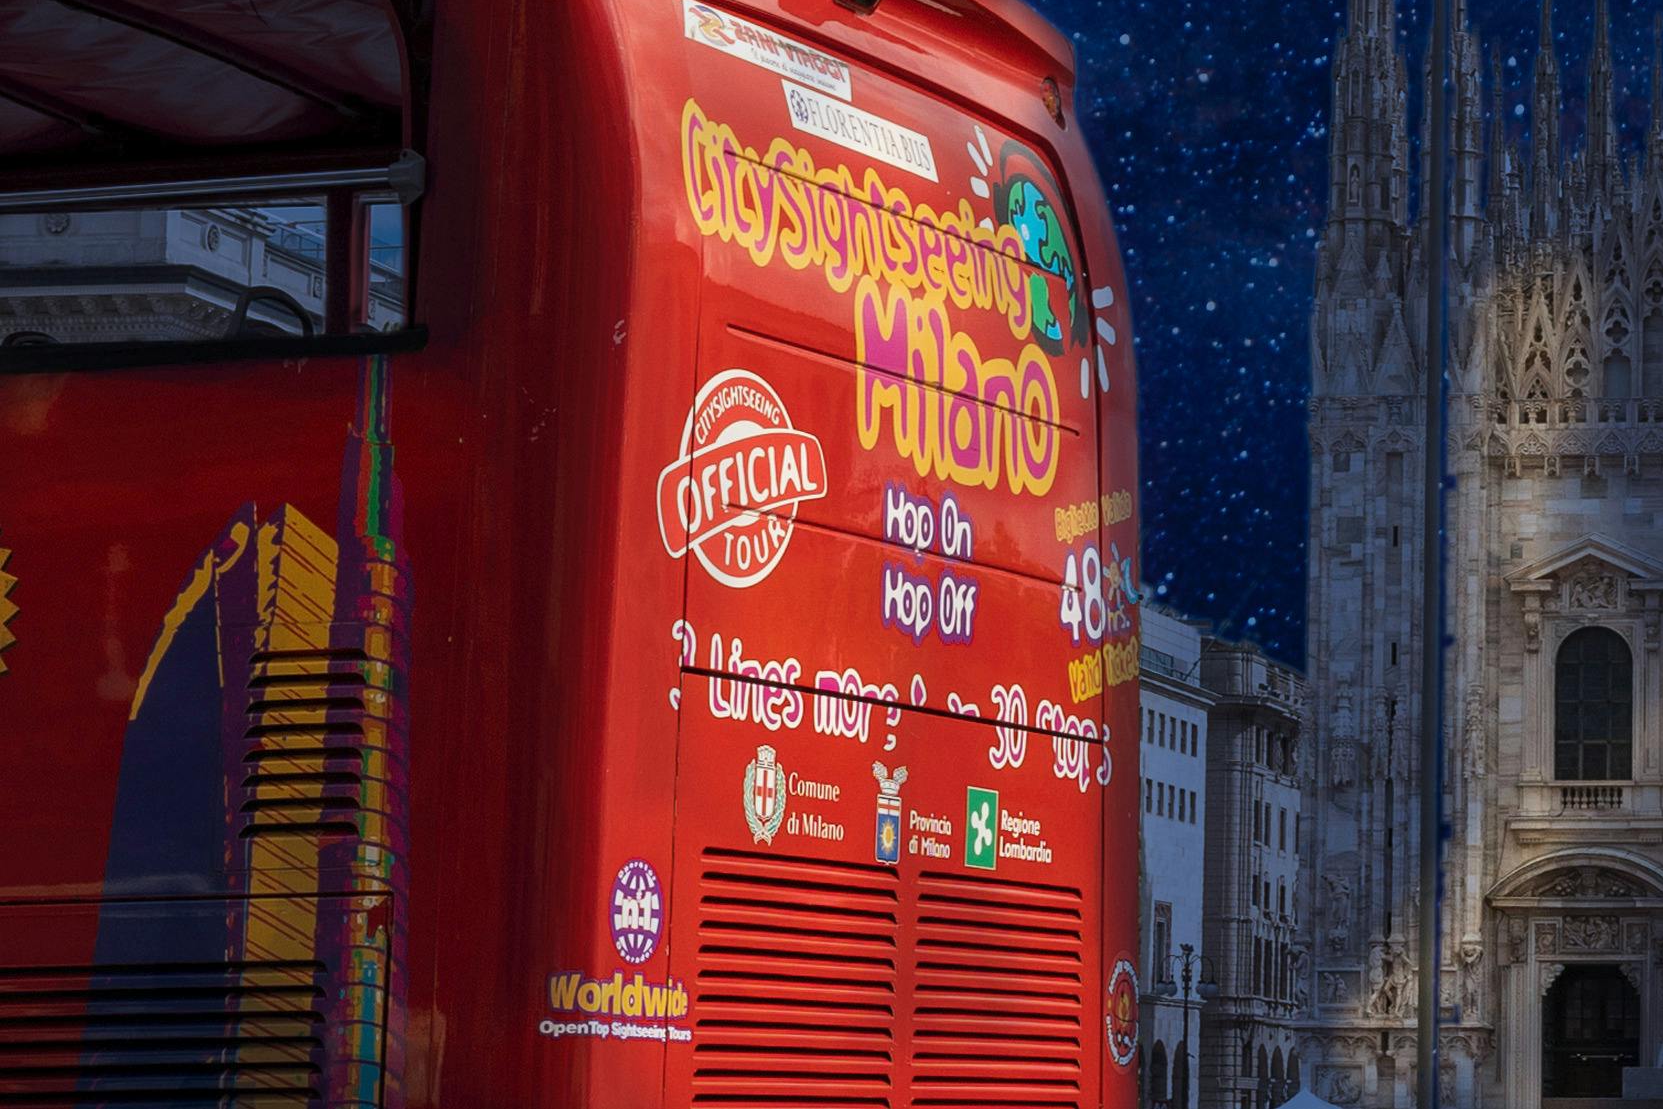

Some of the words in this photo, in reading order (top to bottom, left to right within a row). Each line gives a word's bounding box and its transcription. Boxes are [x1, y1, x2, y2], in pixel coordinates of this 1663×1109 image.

[807, 98, 901, 159] FLORENTIA
[898, 133, 931, 172] BUS
[854, 274, 1060, 497] Milano
[694, 385, 781, 445] CITYSIGHTSEEING
[676, 442, 818, 534] OFFICIAL
[723, 514, 786, 571] TOUR
[886, 488, 934, 556] Hop
[940, 497, 972, 558] On
[884, 568, 933, 637] Hop
[938, 576, 977, 637] Off
[1060, 546, 1106, 641] 48
[708, 632, 804, 732] Lines
[988, 683, 1028, 770] 30
[788, 772, 841, 803] Comune
[787, 816, 799, 836] di
[802, 813, 845, 842] Milano
[908, 835, 918, 855] di
[921, 837, 951, 859] Milano
[909, 810, 952, 836] Provincia
[999, 836, 1052, 864] Lombardia
[1001, 810, 1041, 839] Regione
[551, 972, 689, 1018] Worldwide
[611, 1021, 667, 1042] Sightseeing
[667, 1025, 692, 1042] Tours
